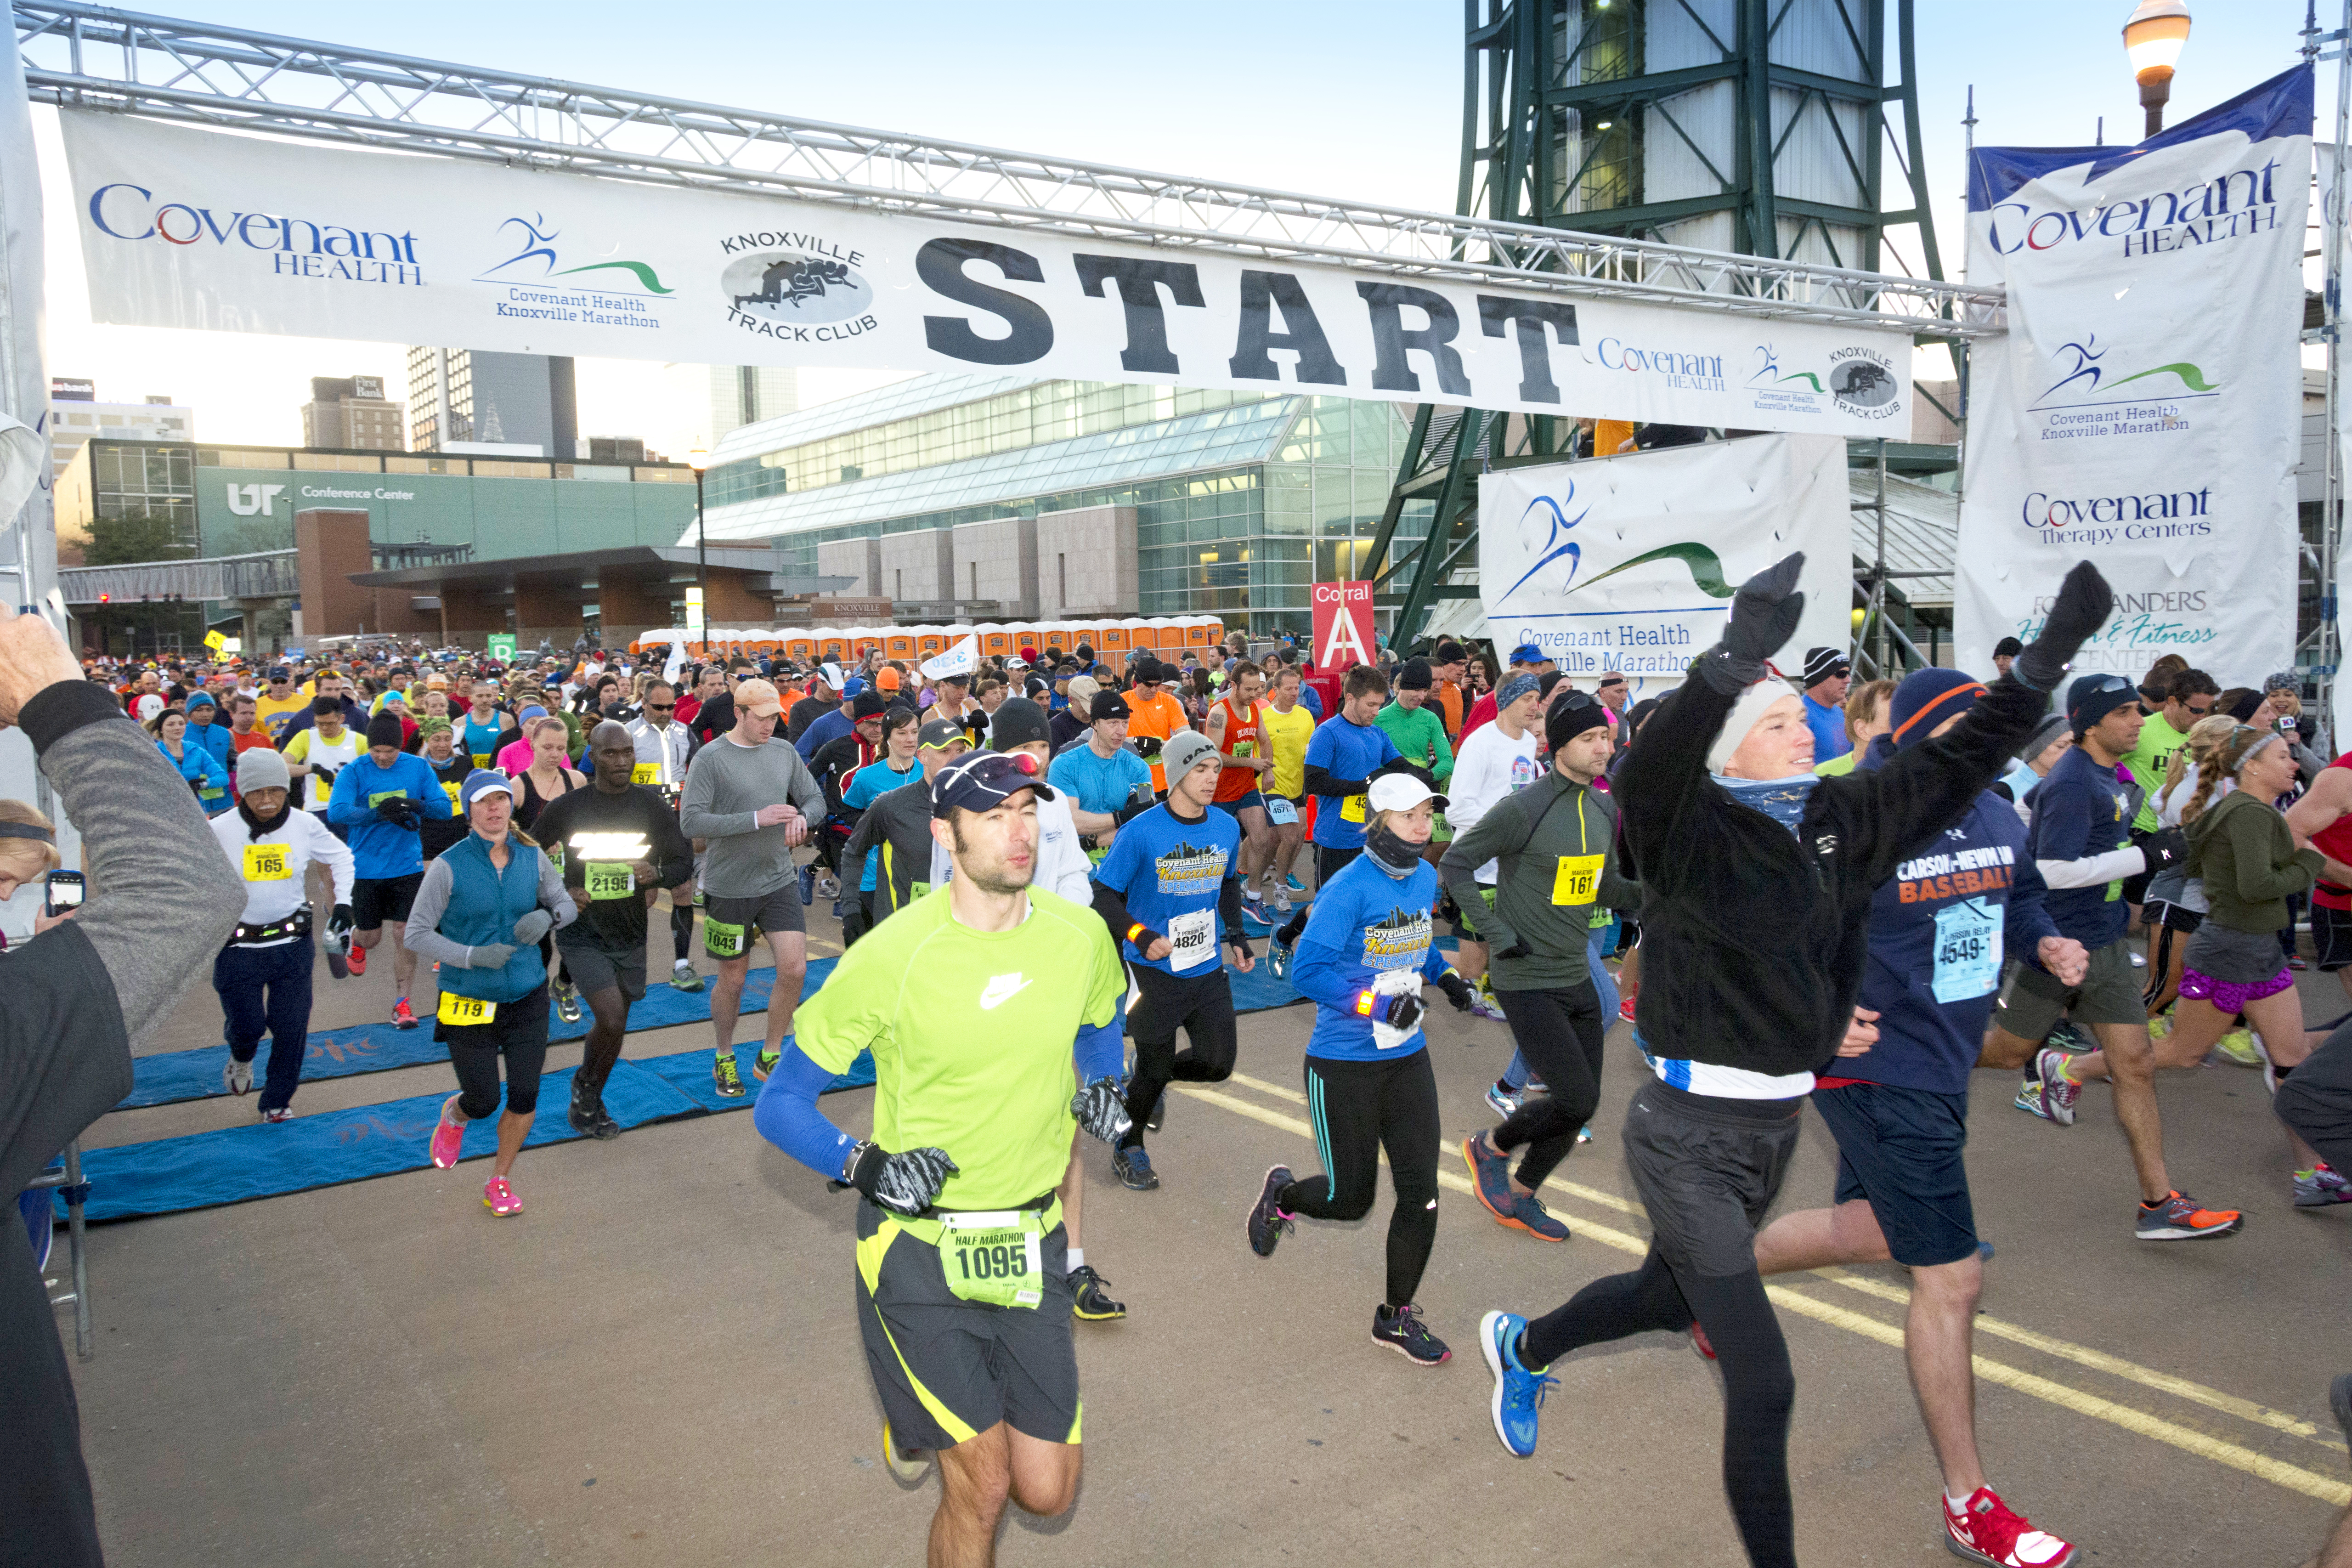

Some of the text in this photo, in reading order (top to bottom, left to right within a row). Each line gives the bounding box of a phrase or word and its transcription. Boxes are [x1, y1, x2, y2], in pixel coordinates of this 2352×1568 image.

[1990, 157, 2280, 255] Covenant
[90, 184, 419, 264] Covenant
[2124, 206, 2277, 257] HEALTH
[720, 232, 864, 267] KNOXVILLE
[274, 254, 422, 285] HEALTH
[510, 288, 646, 311] Covenant Health
[497, 303, 660, 328] Knoxville Marathon
[727, 306, 877, 342] TRACK CLUB
[916, 237, 1580, 404] START
[1598, 338, 1723, 376] Covenant
[1829, 347, 1892, 369] KNOXVILLE
[356, 376, 377, 387] First
[1667, 374, 1725, 391] HEALTH
[356, 387, 384, 398] Bank
[1758, 391, 1815, 404] Covenant Health
[1754, 401, 1821, 414] Knoxville Marathon
[1832, 397, 1901, 420] TRACK CLUB
[2050, 406, 2178, 425] Covenant Health
[2041, 419, 2189, 440] Knoxville Marathon
[227, 484, 286, 515] UT
[301, 486, 414, 500] Conference Center
[2023, 486, 2212, 528] Covenant
[2039, 521, 2211, 545] Therapy Centers
[1320, 607, 1370, 668] A
[1520, 624, 1690, 646] Covenant Health
[2126, 614, 2218, 649] Fitness
[1603, 651, 1694, 671] Maratho
[639, 774, 650, 784] 97
[255, 859, 282, 873] 165
[1156, 853, 1228, 867] Covenant Health
[592, 877, 628, 892] 2195
[1158, 881, 1166, 892] 2
[1167, 879, 1202, 892] PERSON
[1570, 876, 1592, 894] 161
[708, 932, 737, 950] 1043
[1365, 924, 1413, 939] Covenant
[1949, 930, 1971, 940] PERSON
[1973, 926, 1991, 935] RELAY
[1362, 953, 1374, 966] 2
[1374, 951, 1414, 968] PERSON
[453, 1002, 482, 1017] 119
[956, 1232, 1025, 1246] HALF MARATHON
[956, 1245, 1028, 1279] 1095
